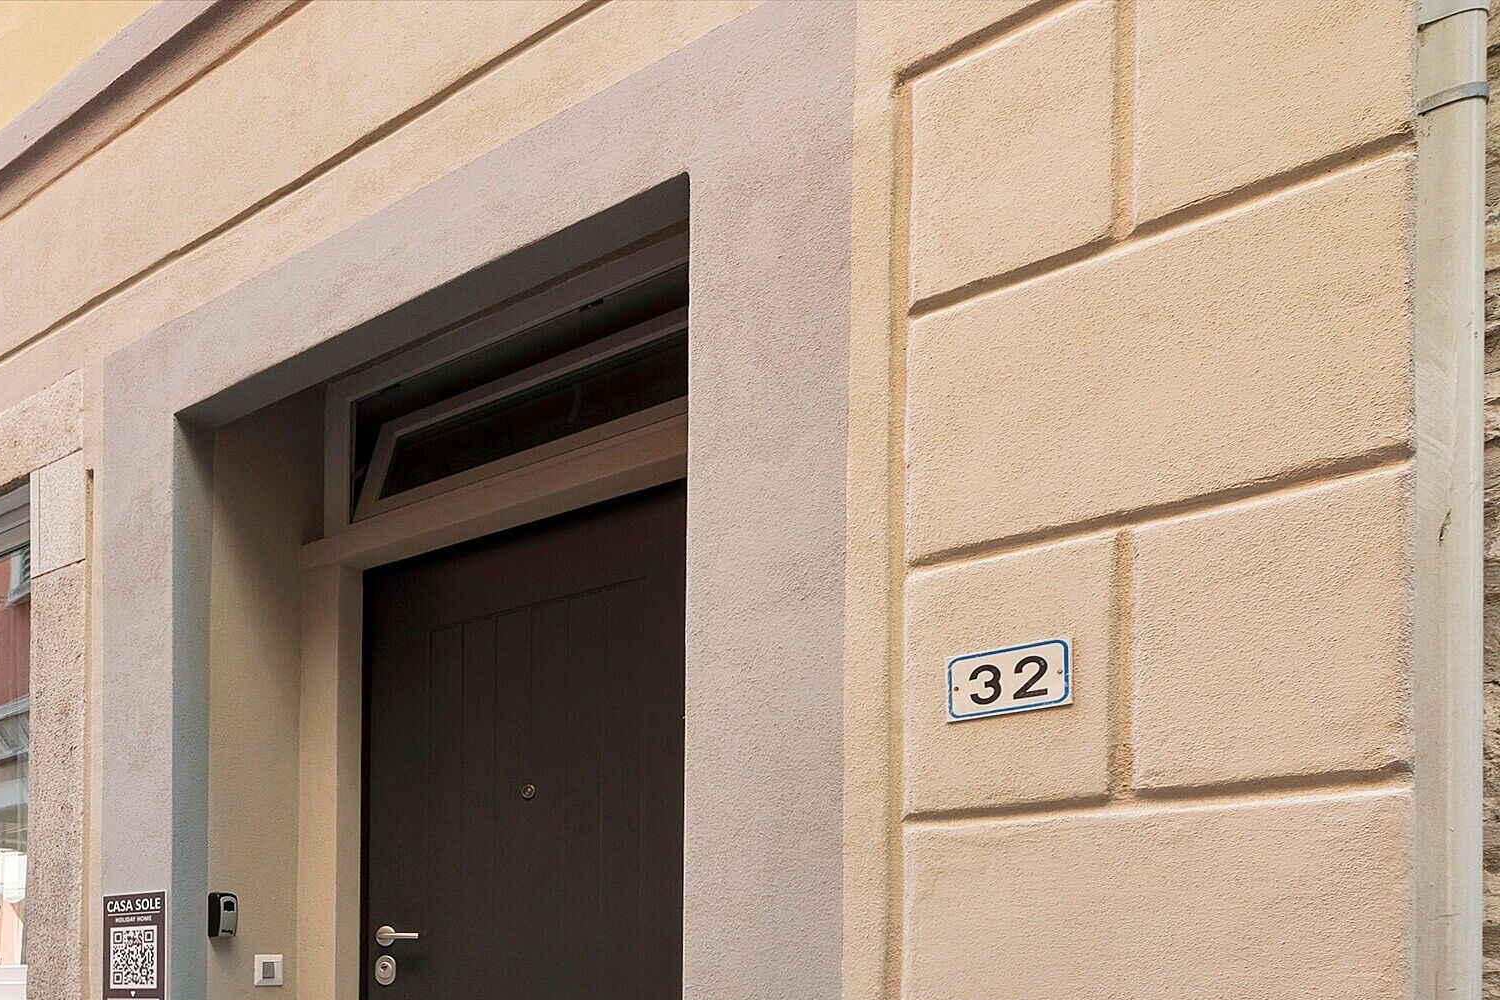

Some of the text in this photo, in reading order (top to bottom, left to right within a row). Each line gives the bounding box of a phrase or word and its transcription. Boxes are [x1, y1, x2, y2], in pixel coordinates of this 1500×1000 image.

[968, 655, 1049, 706] 32
[106, 897, 161, 913] CASA SOLE
